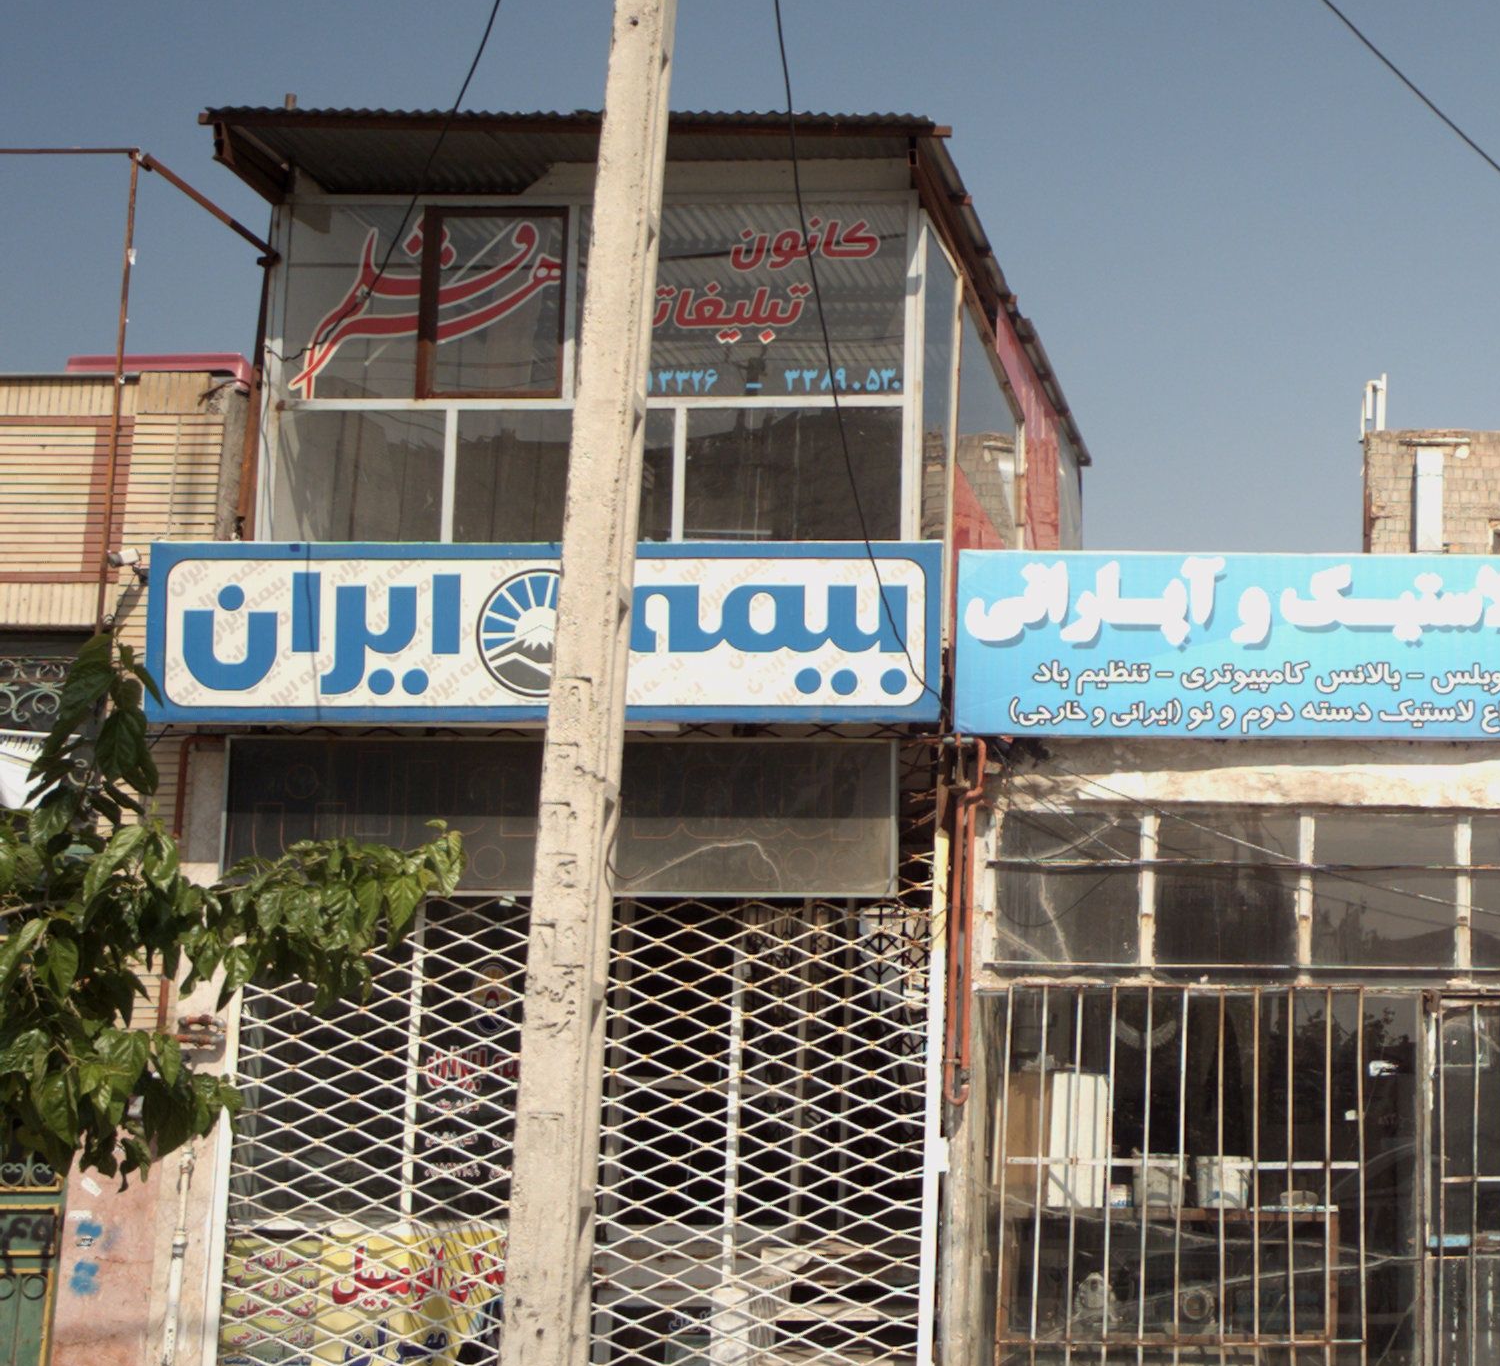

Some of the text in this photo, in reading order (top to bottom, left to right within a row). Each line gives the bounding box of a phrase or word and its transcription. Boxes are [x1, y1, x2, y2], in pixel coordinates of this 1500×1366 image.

[730, 215, 881, 271] کانون
[653, 281, 812, 346] تبلیغات
[1230, 588, 1270, 644] و
[182, 571, 909, 697] بیمه ایران
[1033, 660, 1070, 689] باد
[1076, 661, 1151, 695] تنظیم
[1181, 661, 1310, 693] کامپیوتری
[1315, 662, 1401, 694] بالانس
[1090, 705, 1107, 727] و
[1186, 702, 1214, 730] نو
[1219, 705, 1236, 729] و
[1241, 702, 1296, 734] دوم
[1301, 700, 1372, 722] دسته
[1379, 698, 1475, 728] لاستیک
